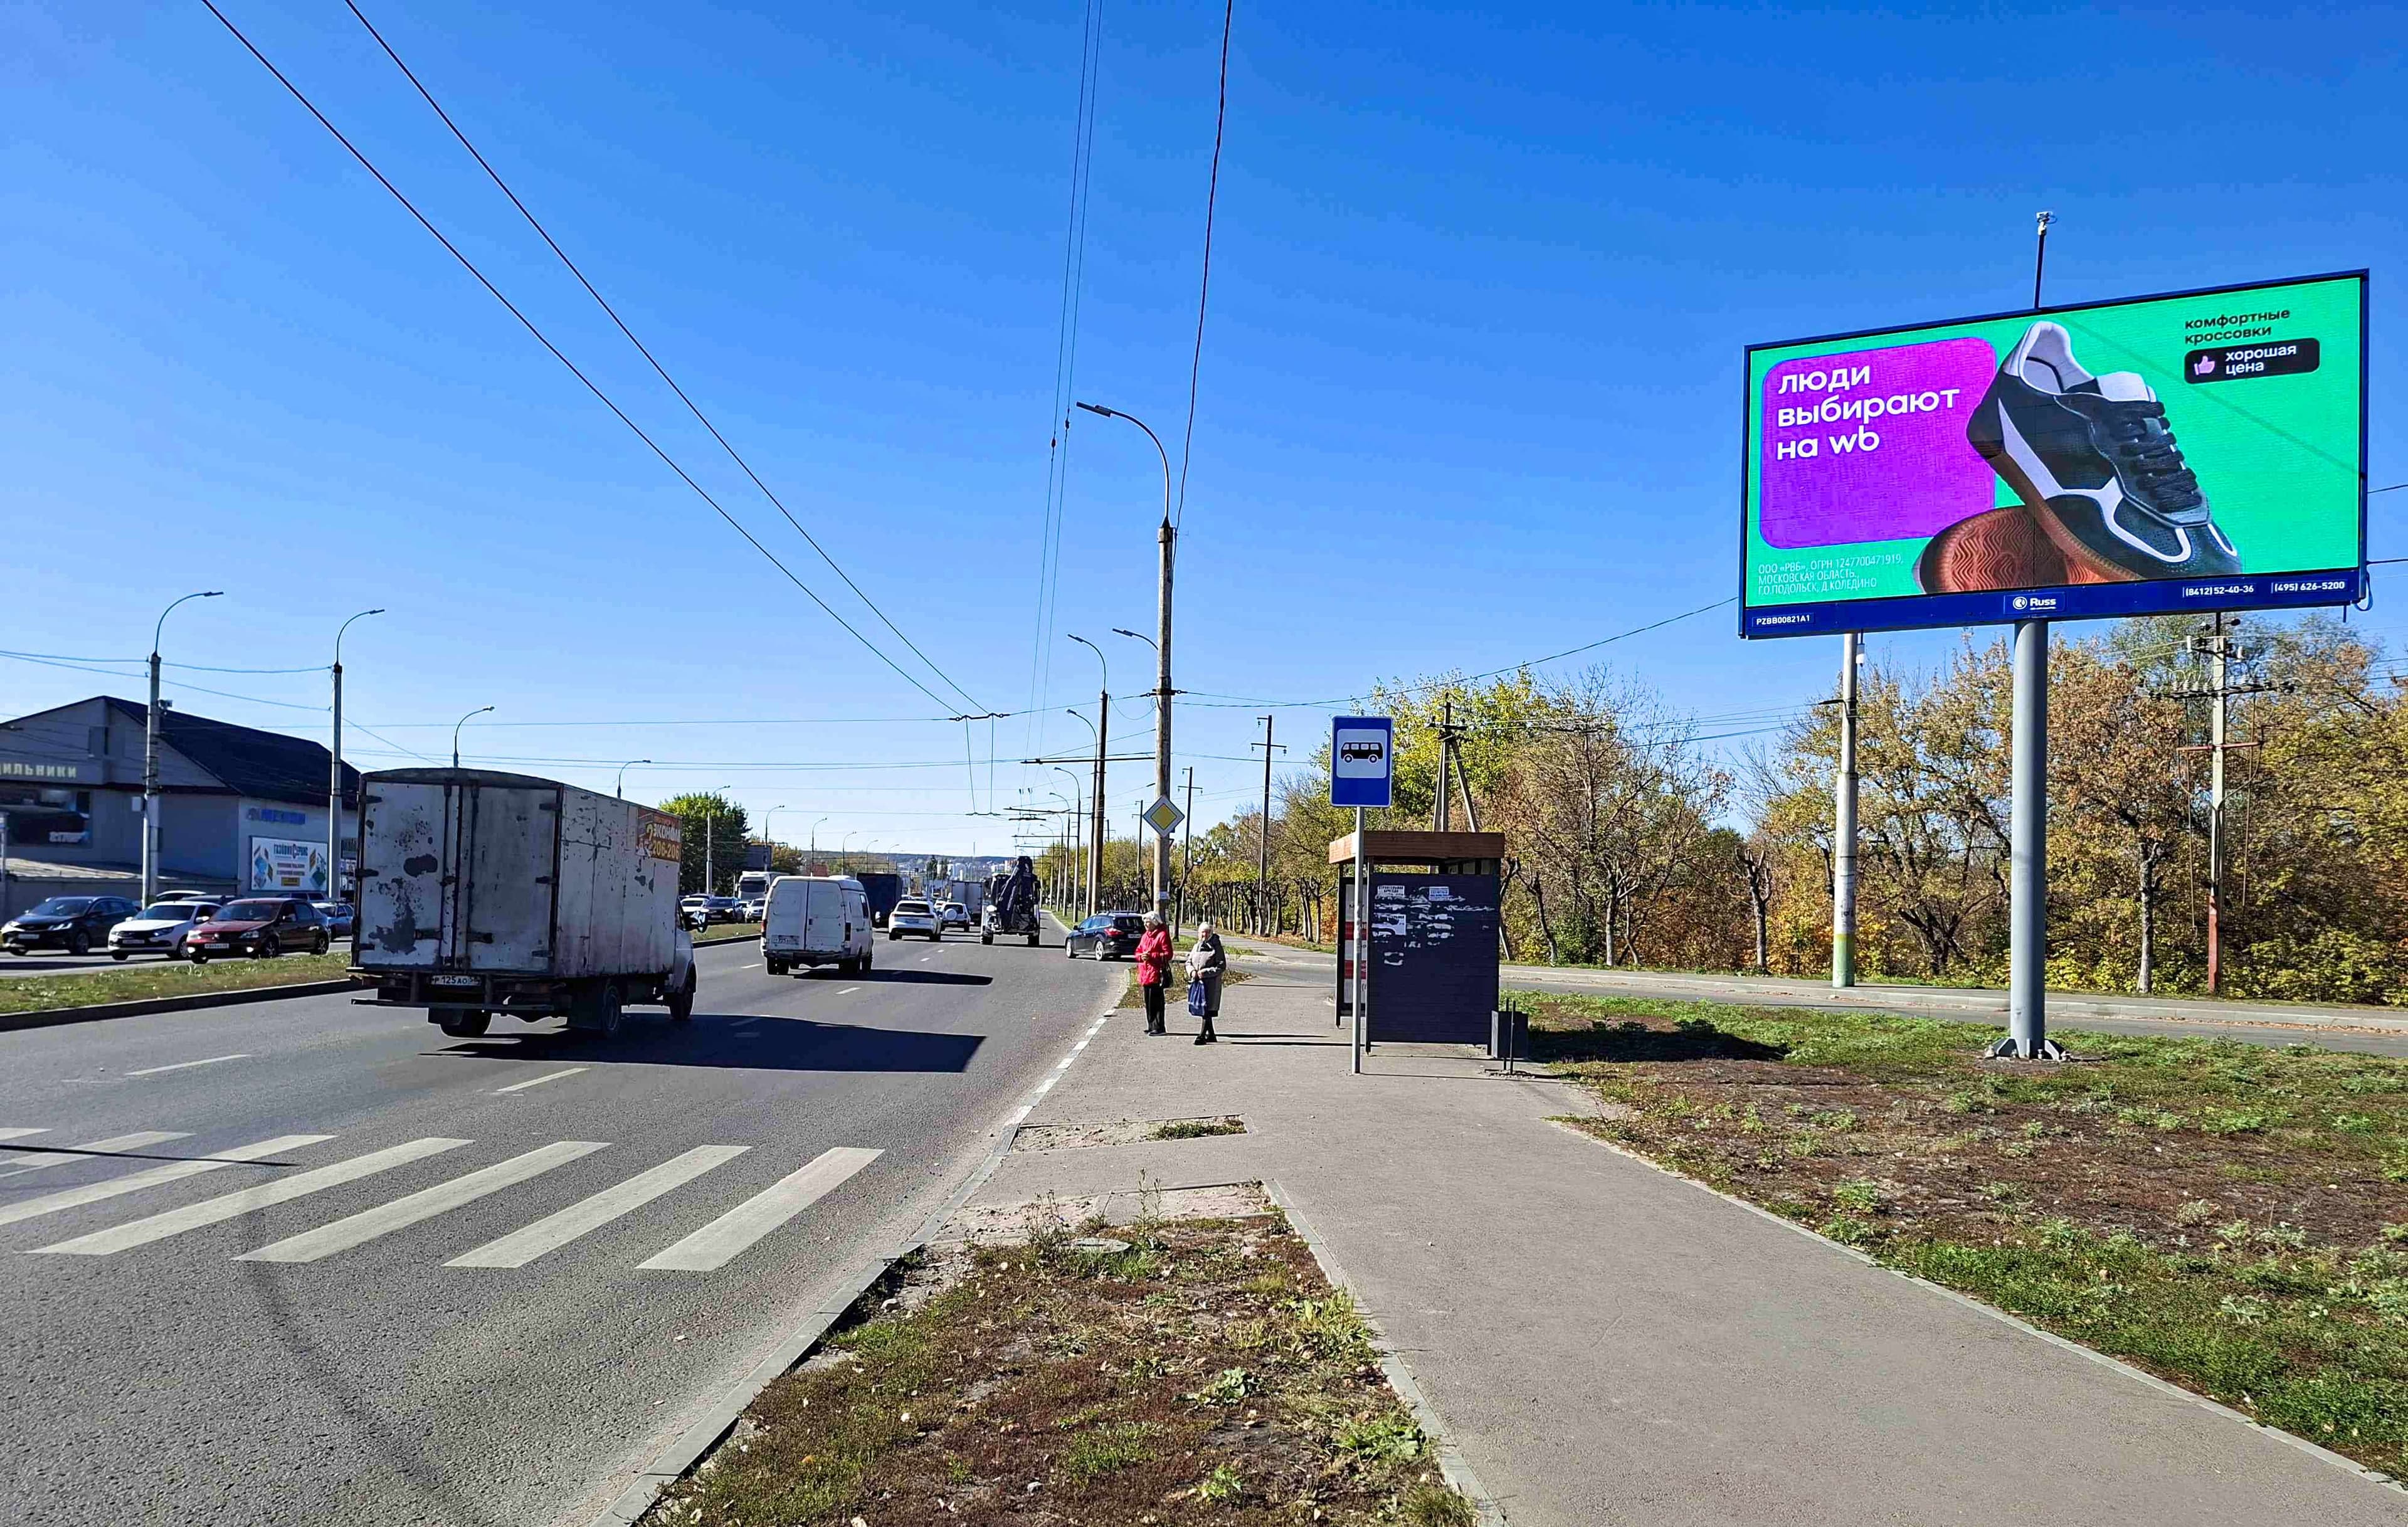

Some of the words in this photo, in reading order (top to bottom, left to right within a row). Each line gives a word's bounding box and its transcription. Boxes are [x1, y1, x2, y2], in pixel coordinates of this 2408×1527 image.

[2185, 309, 2291, 329] комфортные
[2185, 326, 2272, 346] кроссовки
[2226, 345, 2297, 362] хорошая
[2226, 362, 2265, 376] цена
[1778, 366, 1871, 394] люди
[1778, 389, 1960, 427] выбирают
[1777, 438, 1819, 460] на
[1829, 425, 1881, 454] wb
[1758, 563, 1778, 575] ООО
[1810, 559, 1833, 571] ОГРН
[1758, 573, 1815, 585] МОСКОВСКАЯ
[2274, 583, 2298, 592] (495)
[2300, 581, 2345, 591] 626-5200
[2185, 587, 2212, 596] (8412)
[2214, 585, 2254, 594] 52-40-36
[2030, 598, 2057, 607] Russ
[1756, 615, 1810, 625] PZBB00821A1
[0, 763, 77, 778] ИЛЬНИКИ
